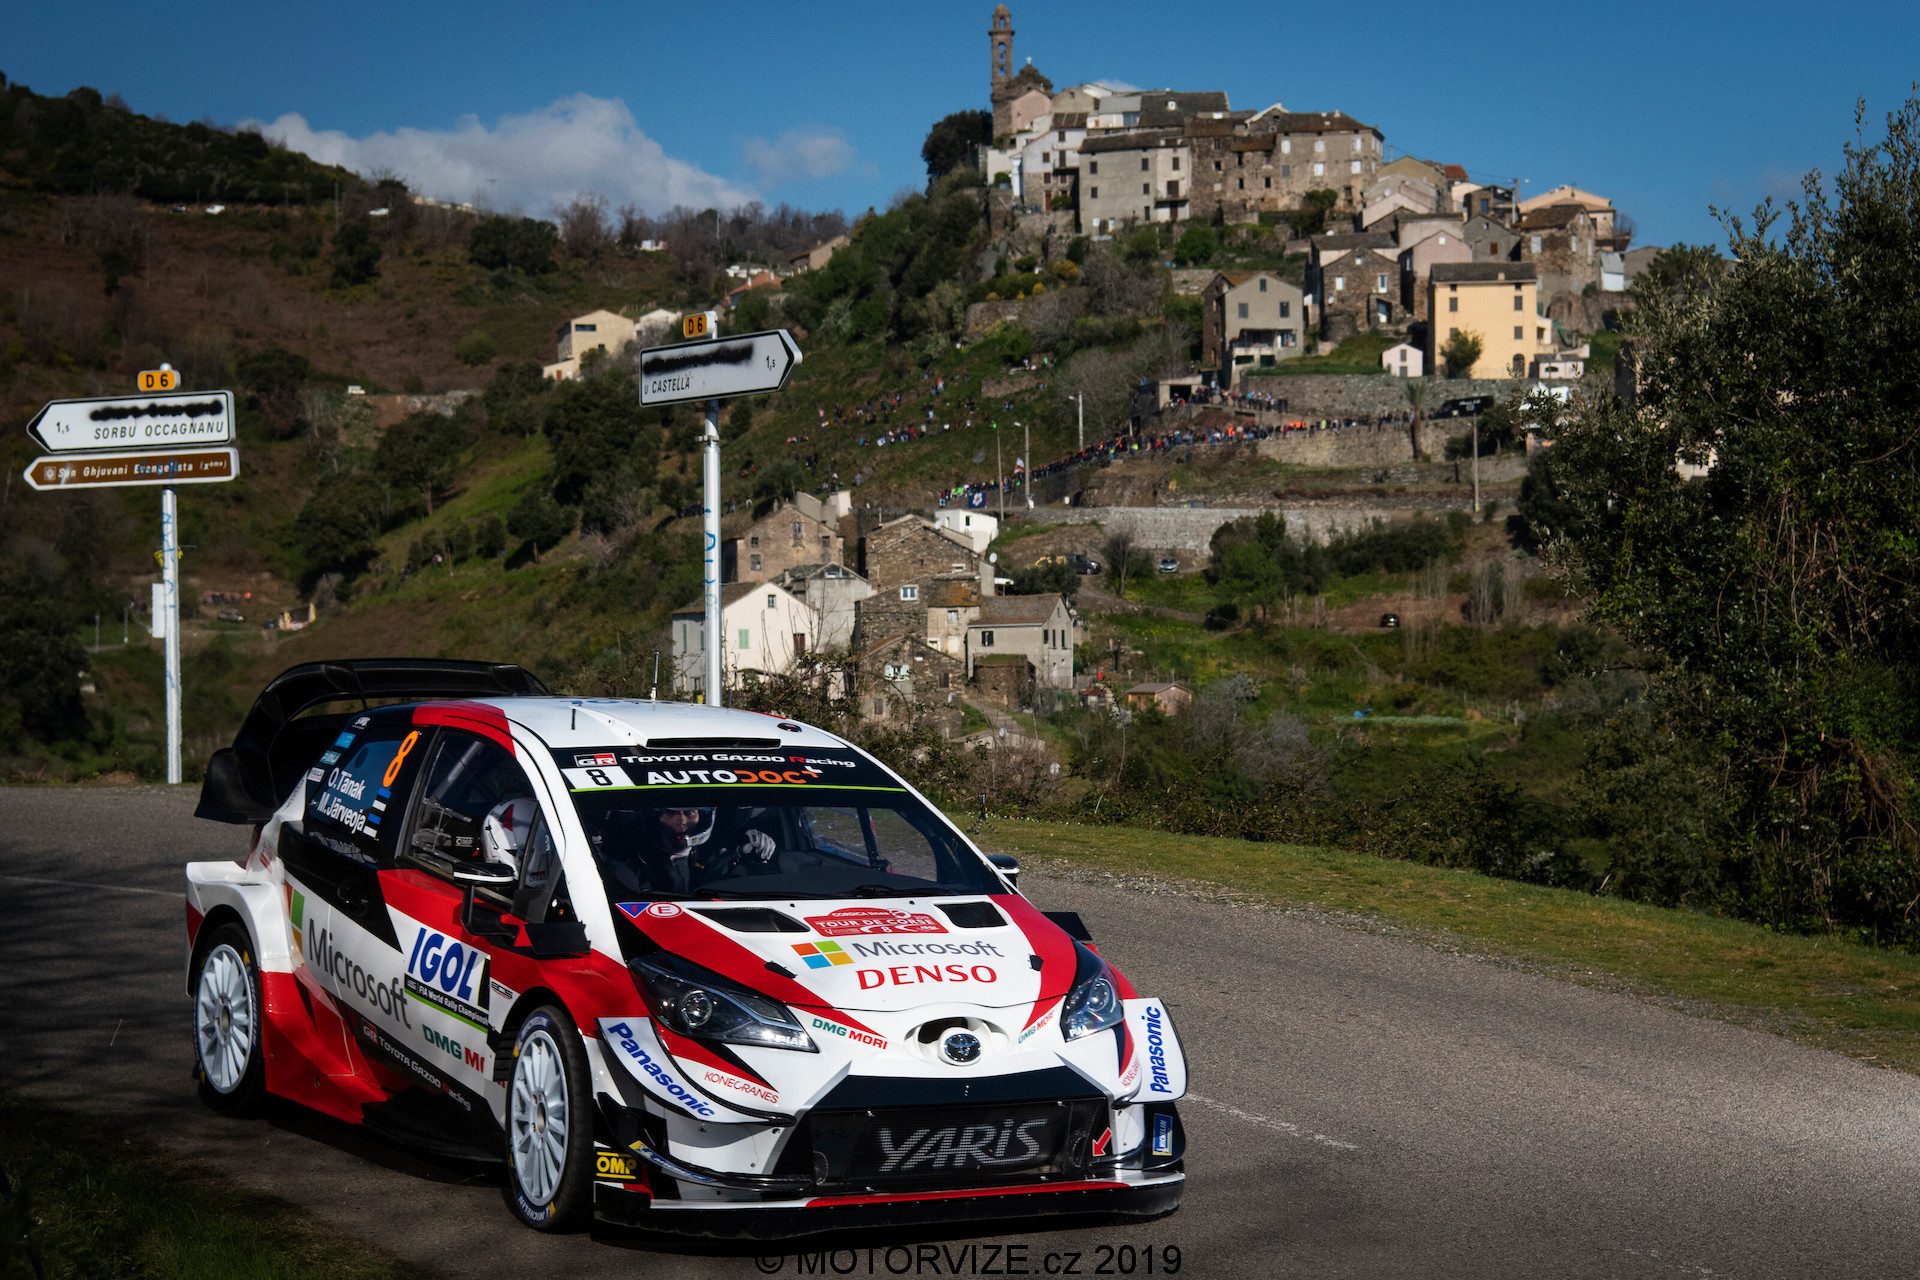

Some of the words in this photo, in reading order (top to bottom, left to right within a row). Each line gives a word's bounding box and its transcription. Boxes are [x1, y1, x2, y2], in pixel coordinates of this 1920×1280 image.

[94, 425, 136, 440] SORBU
[145, 421, 223, 437] OCCAGNANU
[83, 464, 128, 478] Ghjuvani
[383, 730, 419, 788] 8
[578, 757, 615, 766] GR
[621, 754, 708, 764] TOYOTA
[789, 756, 856, 768] Racing
[585, 769, 613, 786] 8
[658, 906, 672, 914] E
[816, 920, 858, 928] TOUR
[853, 940, 1004, 958] Microsoft
[309, 917, 412, 1031] Microsoft
[408, 927, 478, 1001] IGOL
[855, 964, 997, 991] DENSO
[422, 1024, 462, 1060] DMG
[812, 1018, 847, 1036] DMG
[848, 1030, 888, 1050] MORI
[1018, 1026, 1036, 1044] DMG
[1069, 1025, 1089, 1038] PIAA
[1141, 1006, 1172, 1094] Panasonic
[379, 1036, 410, 1066] TOYOTA
[442, 1082, 471, 1112] Racing
[608, 1022, 715, 1118] Panasonic
[703, 1071, 780, 1104] KONECRANES
[596, 1156, 637, 1174] OMP
